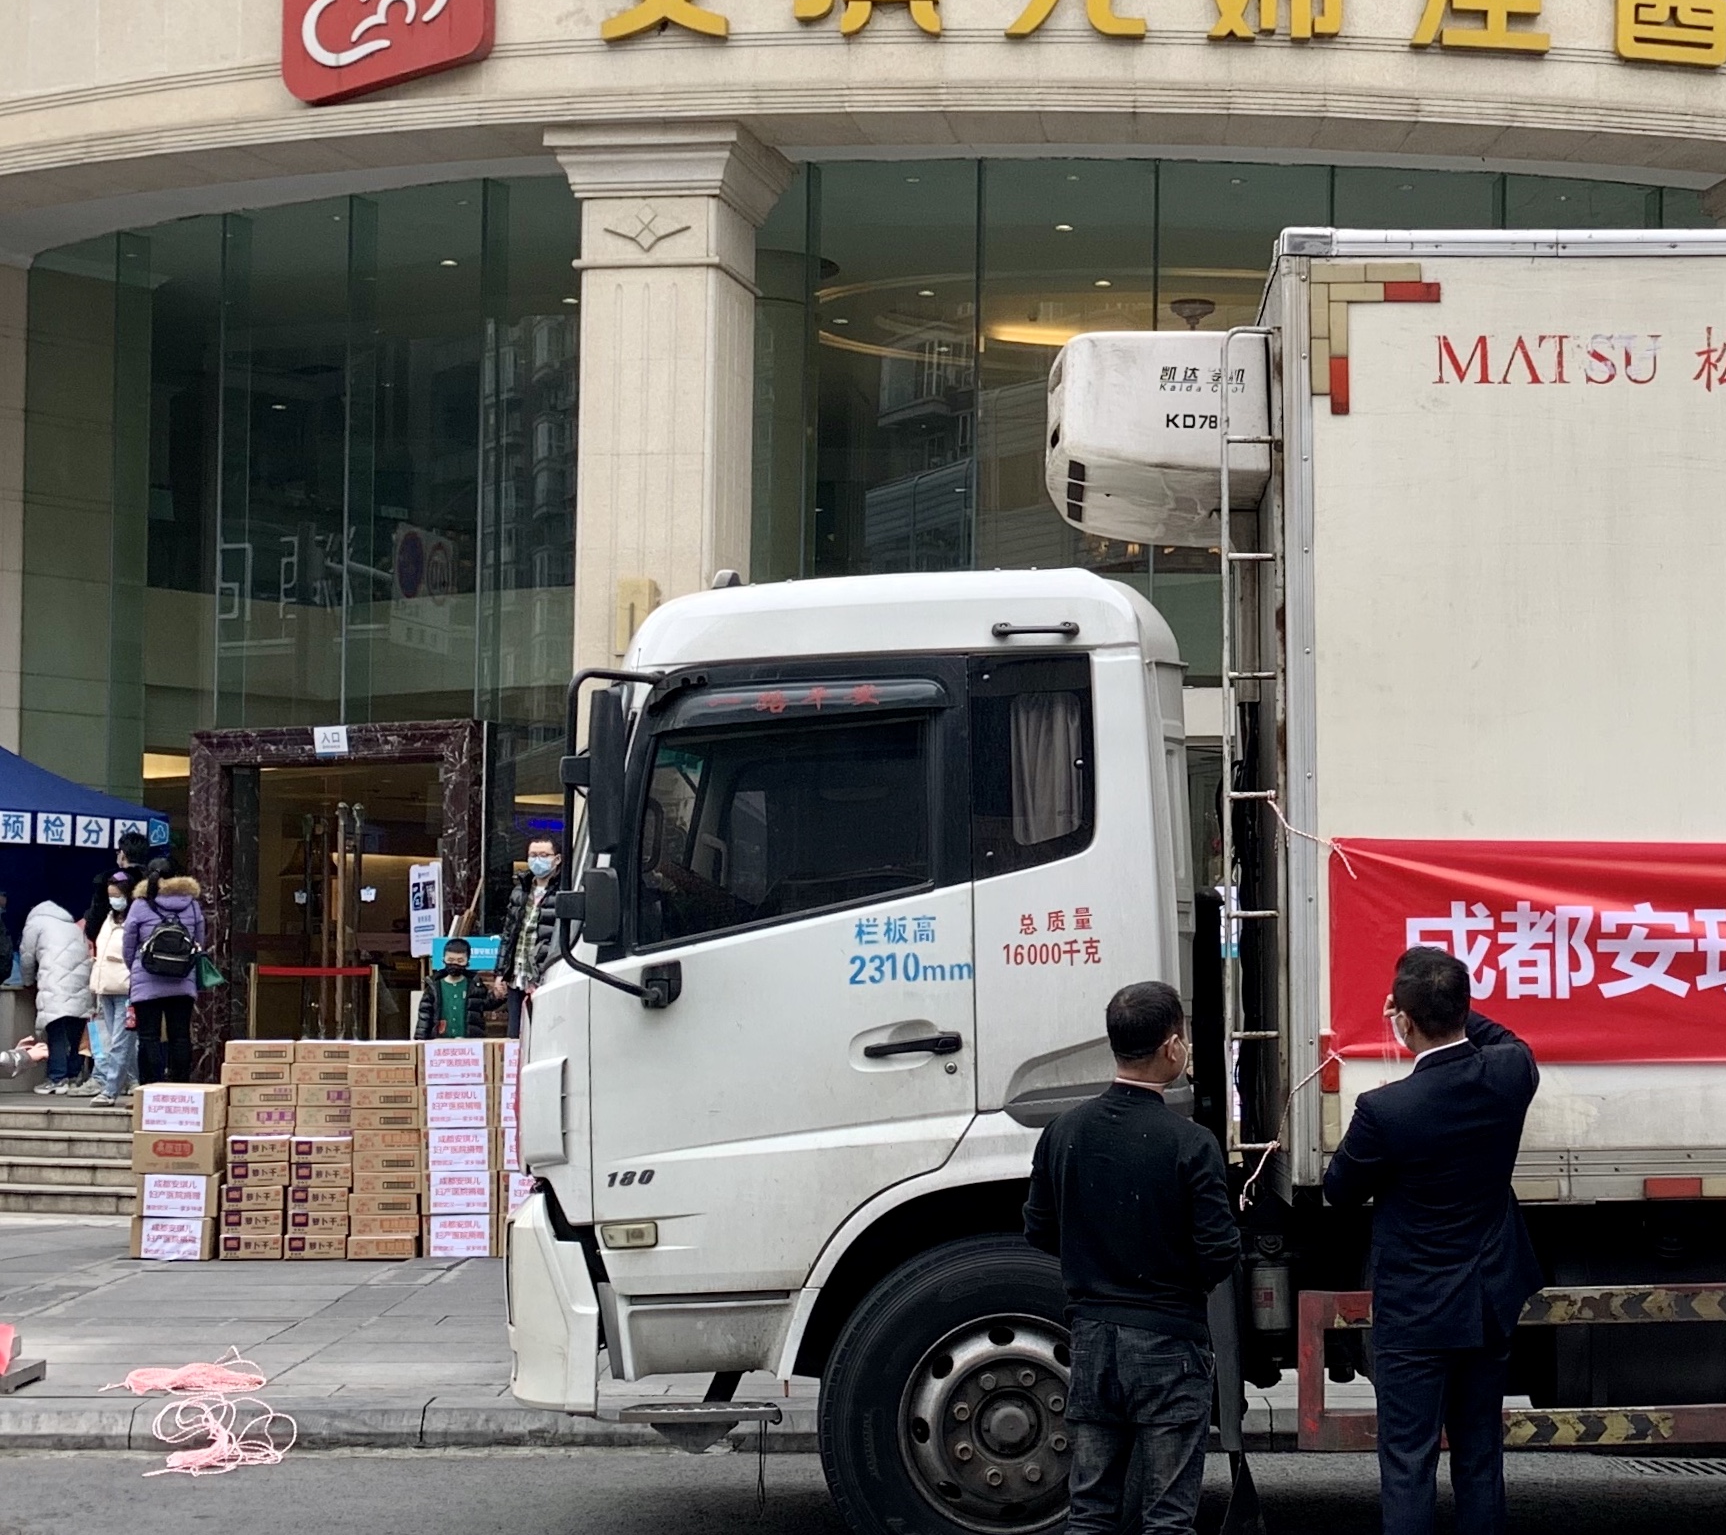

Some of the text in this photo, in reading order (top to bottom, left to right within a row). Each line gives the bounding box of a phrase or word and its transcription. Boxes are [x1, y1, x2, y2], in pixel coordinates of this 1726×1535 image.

[1432, 333, 1663, 386] MATSU
[1211, 384, 1245, 394] Col
[1166, 413, 1230, 429] KD78
[707, 683, 884, 715] 一路平安
[321, 731, 340, 744] 入口
[854, 915, 937, 945] 栏板高
[1019, 907, 1093, 935] 总质量
[1003, 937, 1102, 966] 16000千克
[848, 951, 974, 985] 2310mm
[607, 1169, 656, 1188] 180
